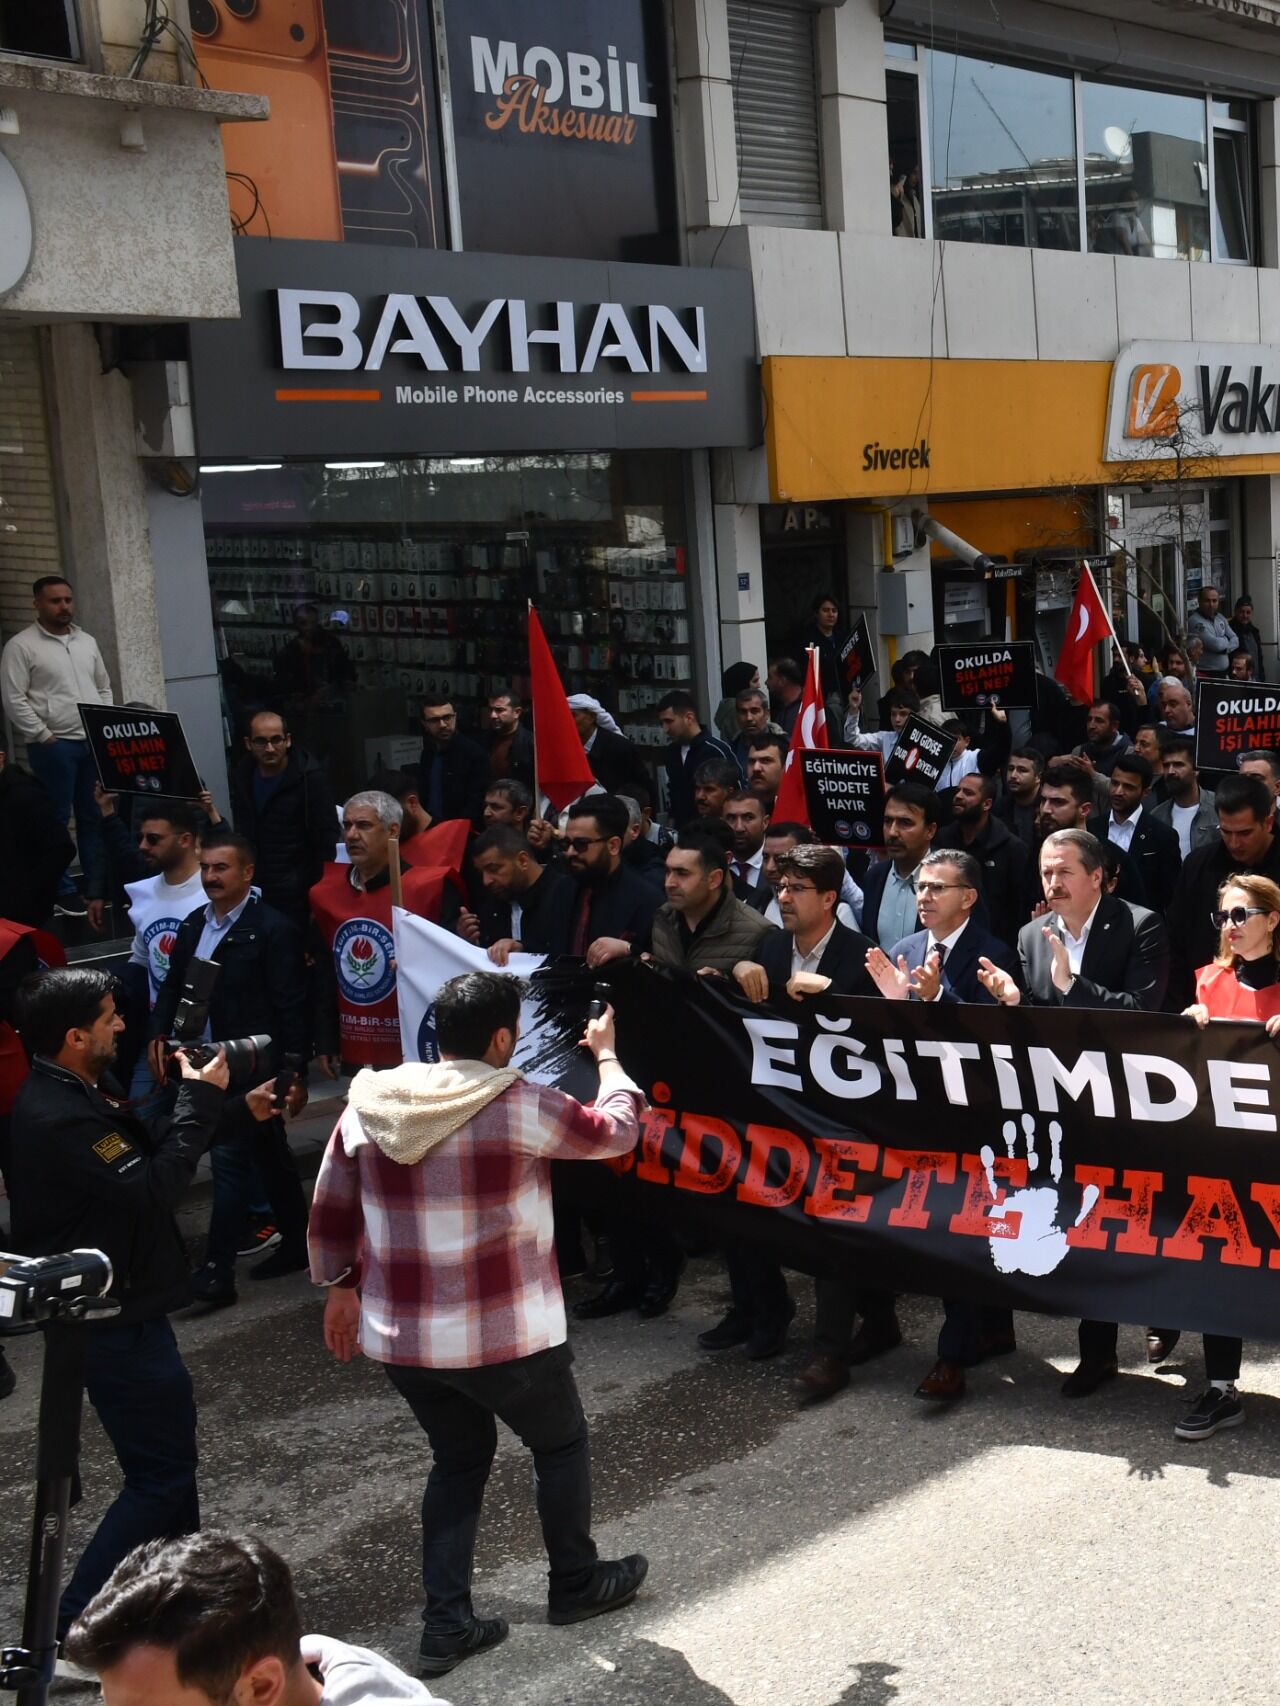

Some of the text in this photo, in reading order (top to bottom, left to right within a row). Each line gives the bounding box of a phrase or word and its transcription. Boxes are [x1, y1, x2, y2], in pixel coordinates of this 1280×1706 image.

[470, 35, 658, 118] MOBİL
[485, 75, 638, 145] Aksesuar
[277, 288, 708, 374] BAYHAN
[395, 386, 625, 405] Mobile Phone Accessories
[862, 440, 931, 471] Siverek
[954, 650, 1012, 670] OKULDA
[955, 662, 1014, 683] SİLAHIN
[984, 678, 1011, 692] NE?
[102, 721, 160, 739] OKULDA
[106, 737, 166, 757] SİLAHIN
[909, 728, 943, 757] BU GİDİŞE
[1220, 733, 1243, 752] İŞİ
[140, 756, 167, 771] NE?
[805, 758, 878, 777] EĞİTİMCİYE
[894, 746, 939, 778] DUR DİYELİM
[817, 779, 870, 795] ŞİDDETE
[827, 798, 866, 812] HAYIR
[742, 1013, 1277, 1133] EĞİTİMDE
[612, 1081, 1028, 1240] İDDETE
